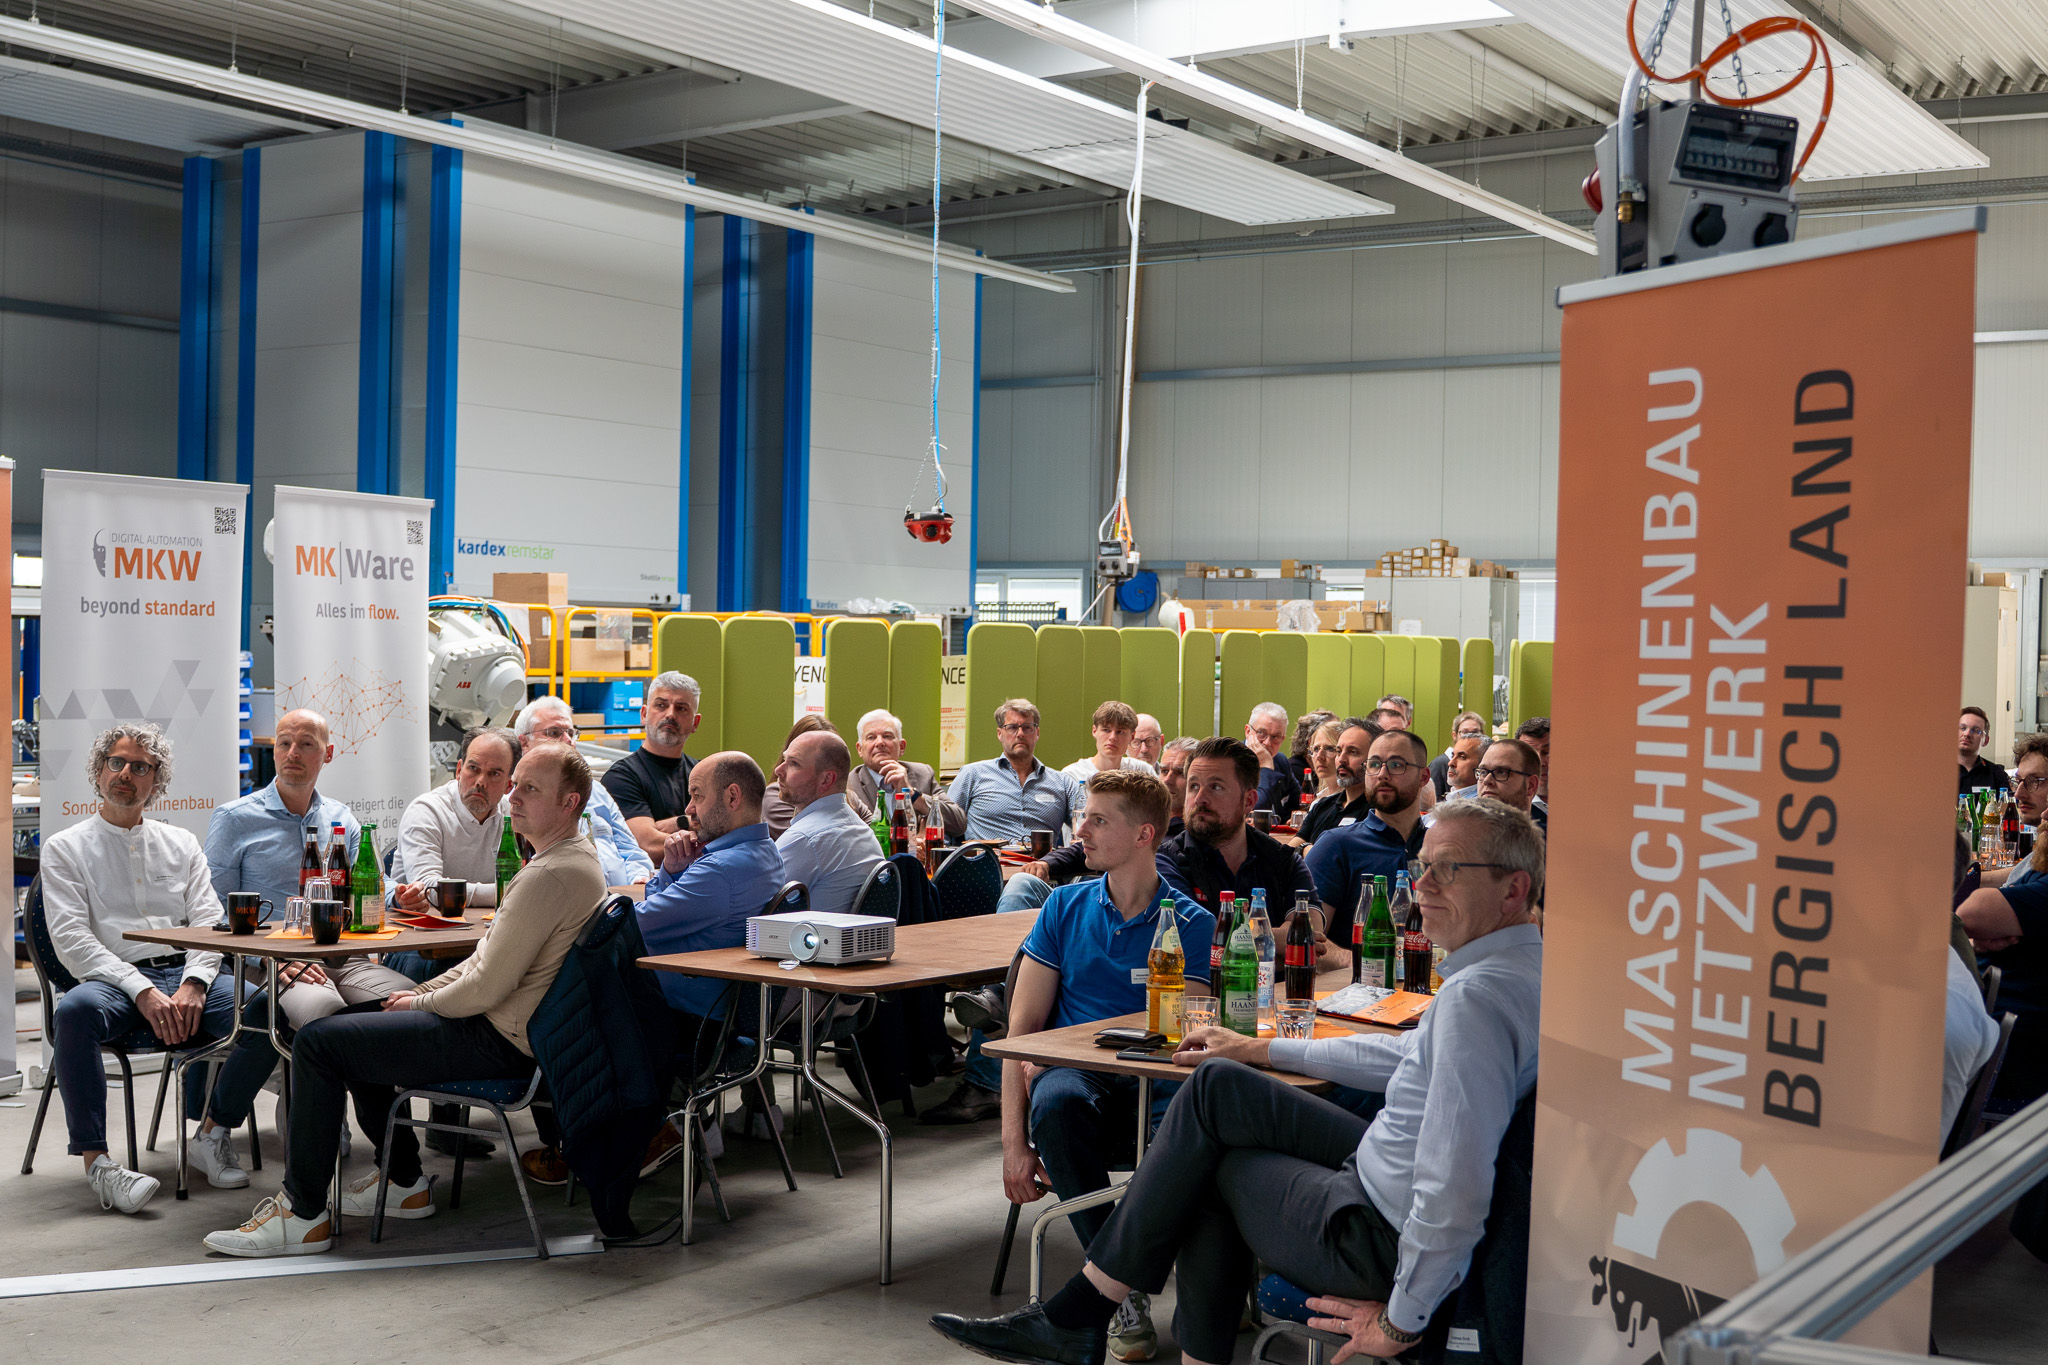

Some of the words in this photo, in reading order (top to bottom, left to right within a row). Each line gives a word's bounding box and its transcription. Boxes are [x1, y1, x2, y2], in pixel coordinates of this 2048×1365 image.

[1786, 369, 1854, 619] LAND
[111, 532, 144, 544] DIGITAL
[146, 535, 203, 547] AUTOMATION
[114, 546, 202, 581] MKW
[80, 596, 140, 618] beyond
[144, 599, 215, 617] standard
[316, 603, 347, 618] Alles
[350, 603, 365, 619] im
[368, 604, 400, 620] flow.
[456, 681, 472, 689] ABB
[1621, 367, 1703, 1092] MASCHINENBAU
[387, 796, 404, 809] die
[382, 815, 398, 829] die
[1688, 601, 1768, 1110] NETZWERK
[1762, 665, 1844, 1129] BERGISCH
[235, 906, 257, 915] MKW
[1231, 1001, 1257, 1009] HAANE
